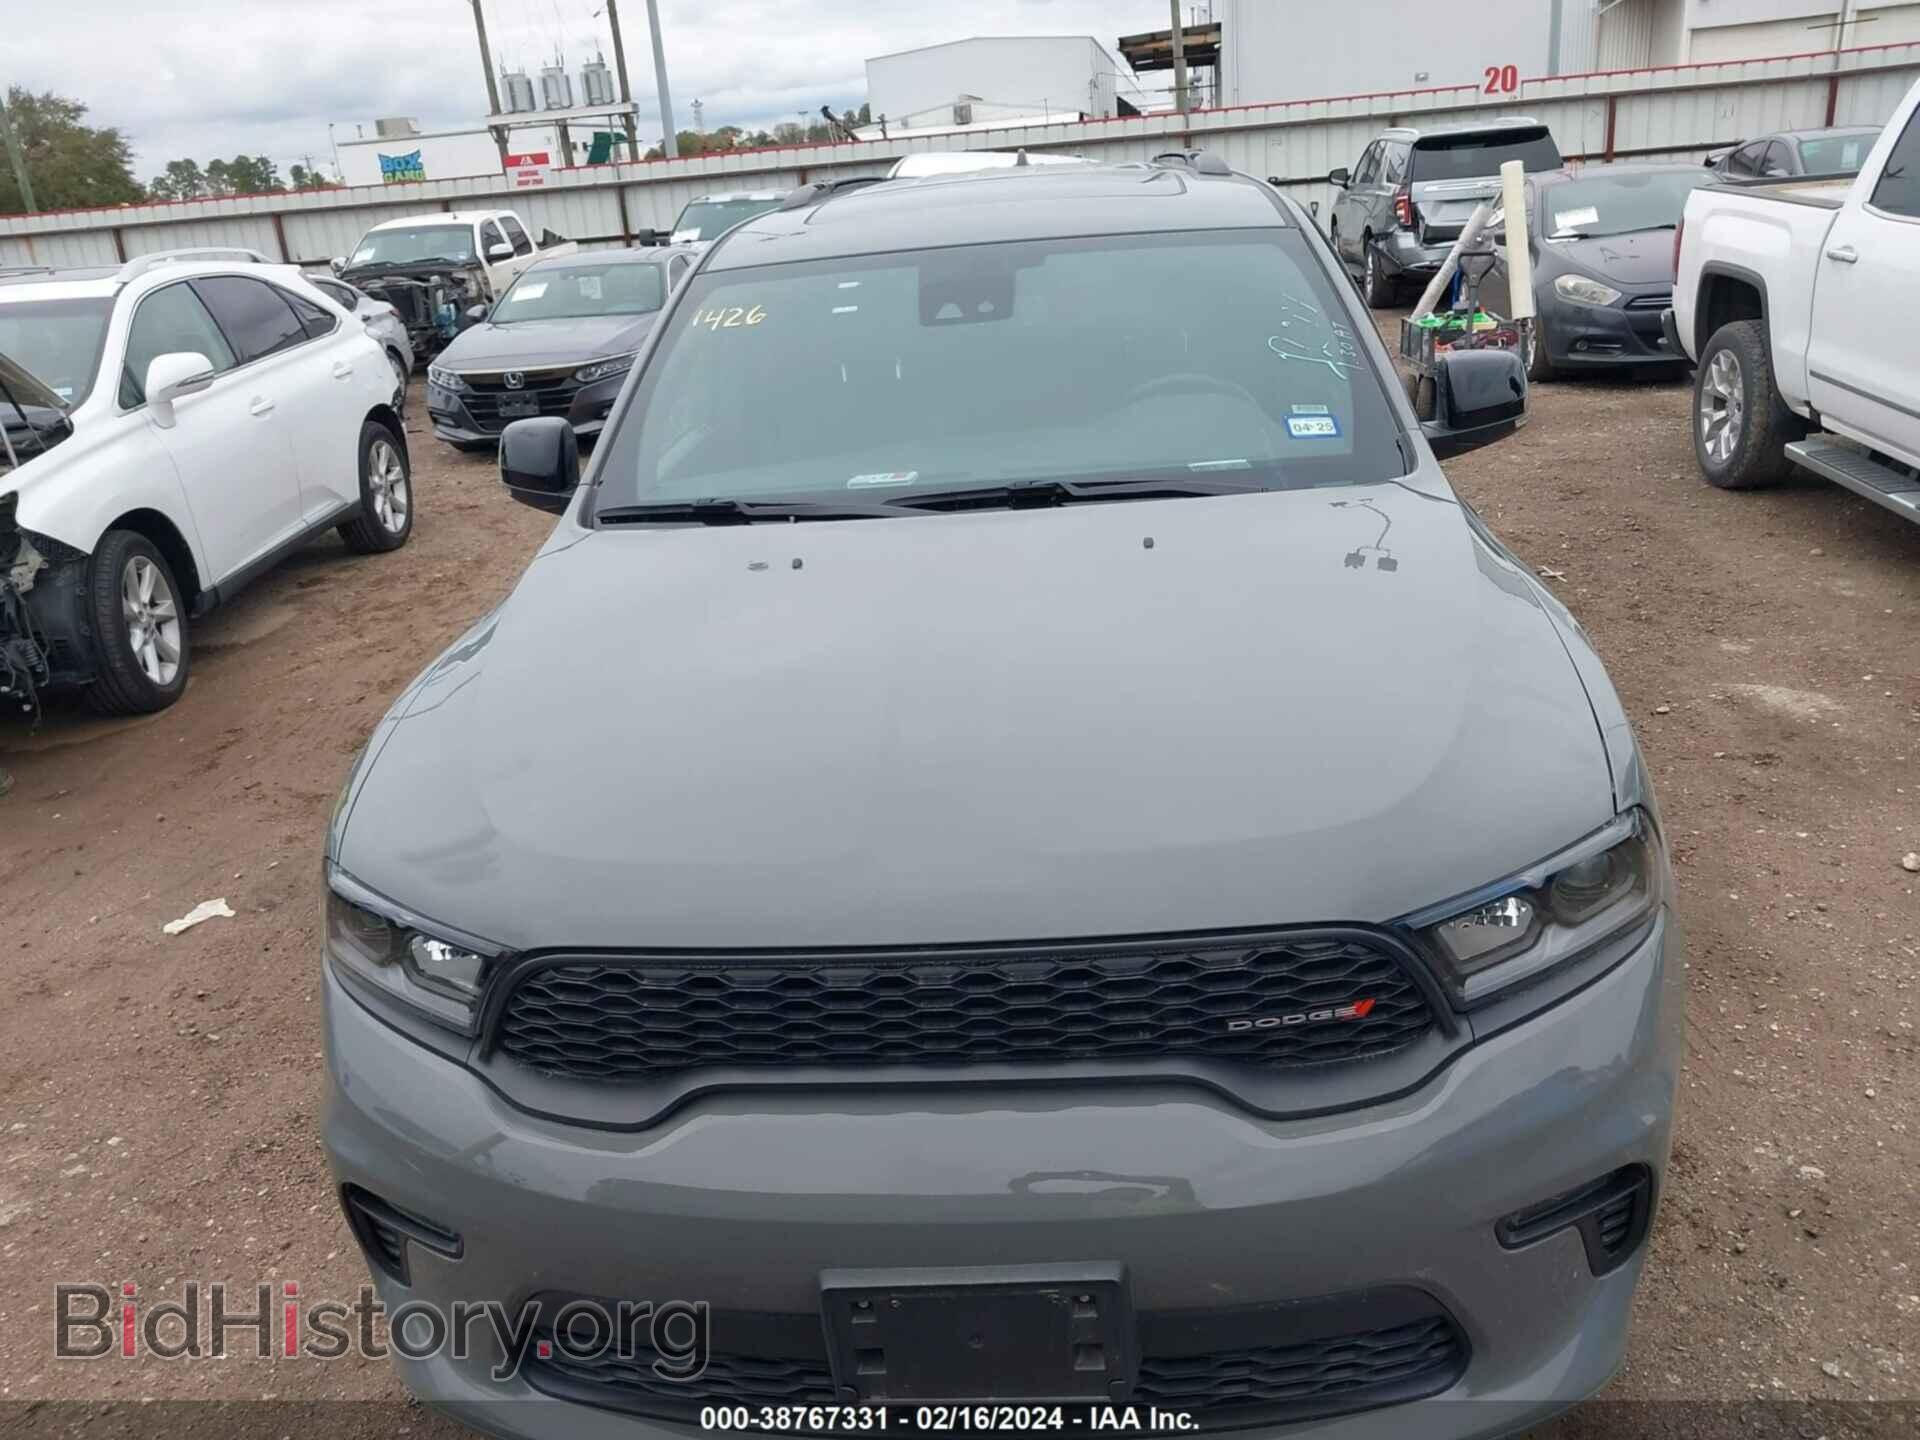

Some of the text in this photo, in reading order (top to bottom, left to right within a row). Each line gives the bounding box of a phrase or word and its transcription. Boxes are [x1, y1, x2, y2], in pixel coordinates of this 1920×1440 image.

[1484, 65, 1517, 94] 20
[378, 150, 423, 172] BOX
[692, 304, 768, 331] 1426
[1228, 1004, 1358, 1032] DODGE
